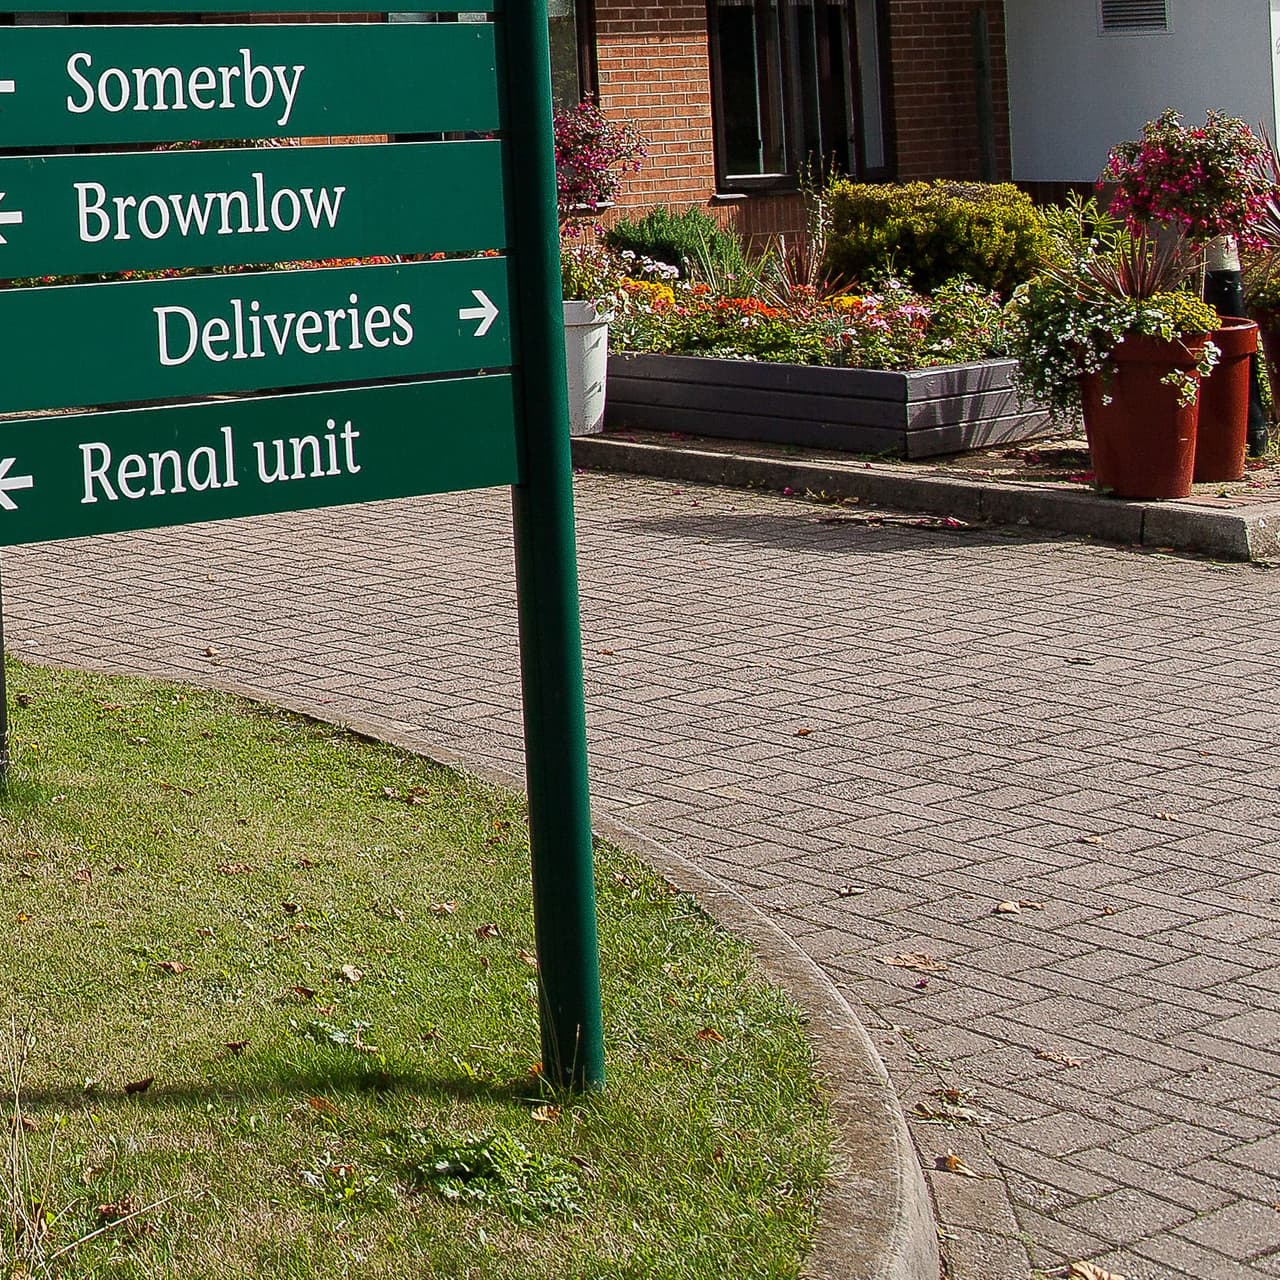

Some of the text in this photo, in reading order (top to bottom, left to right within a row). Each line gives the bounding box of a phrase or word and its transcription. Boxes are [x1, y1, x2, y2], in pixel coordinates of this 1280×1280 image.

[66, 48, 305, 126] Somerby
[73, 172, 346, 243] Brownlow
[152, 293, 413, 366] Deliveries
[79, 419, 362, 504] Renal unit
